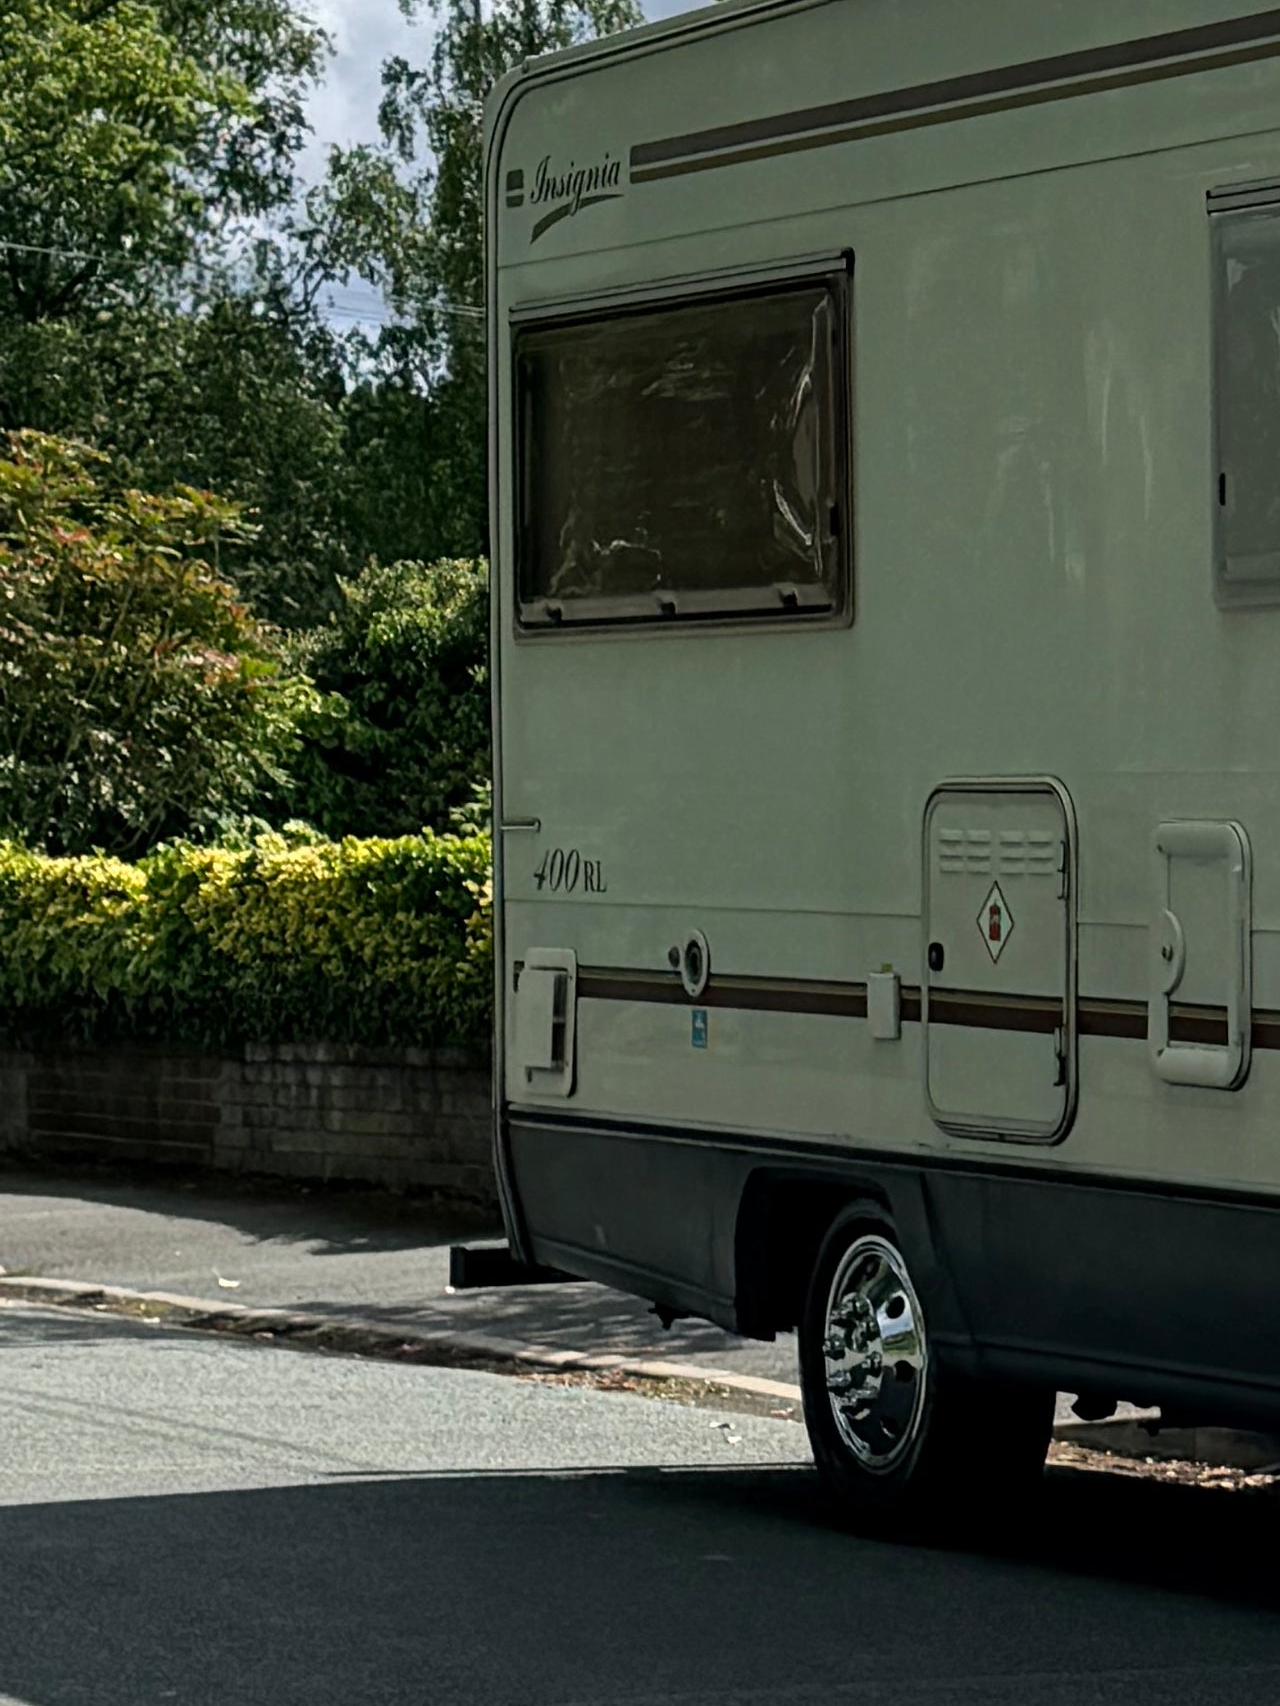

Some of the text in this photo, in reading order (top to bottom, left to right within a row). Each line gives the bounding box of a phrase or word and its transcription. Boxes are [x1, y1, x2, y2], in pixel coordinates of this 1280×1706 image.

[531, 153, 621, 217] Insignia
[533, 849, 607, 892] 400 RL
